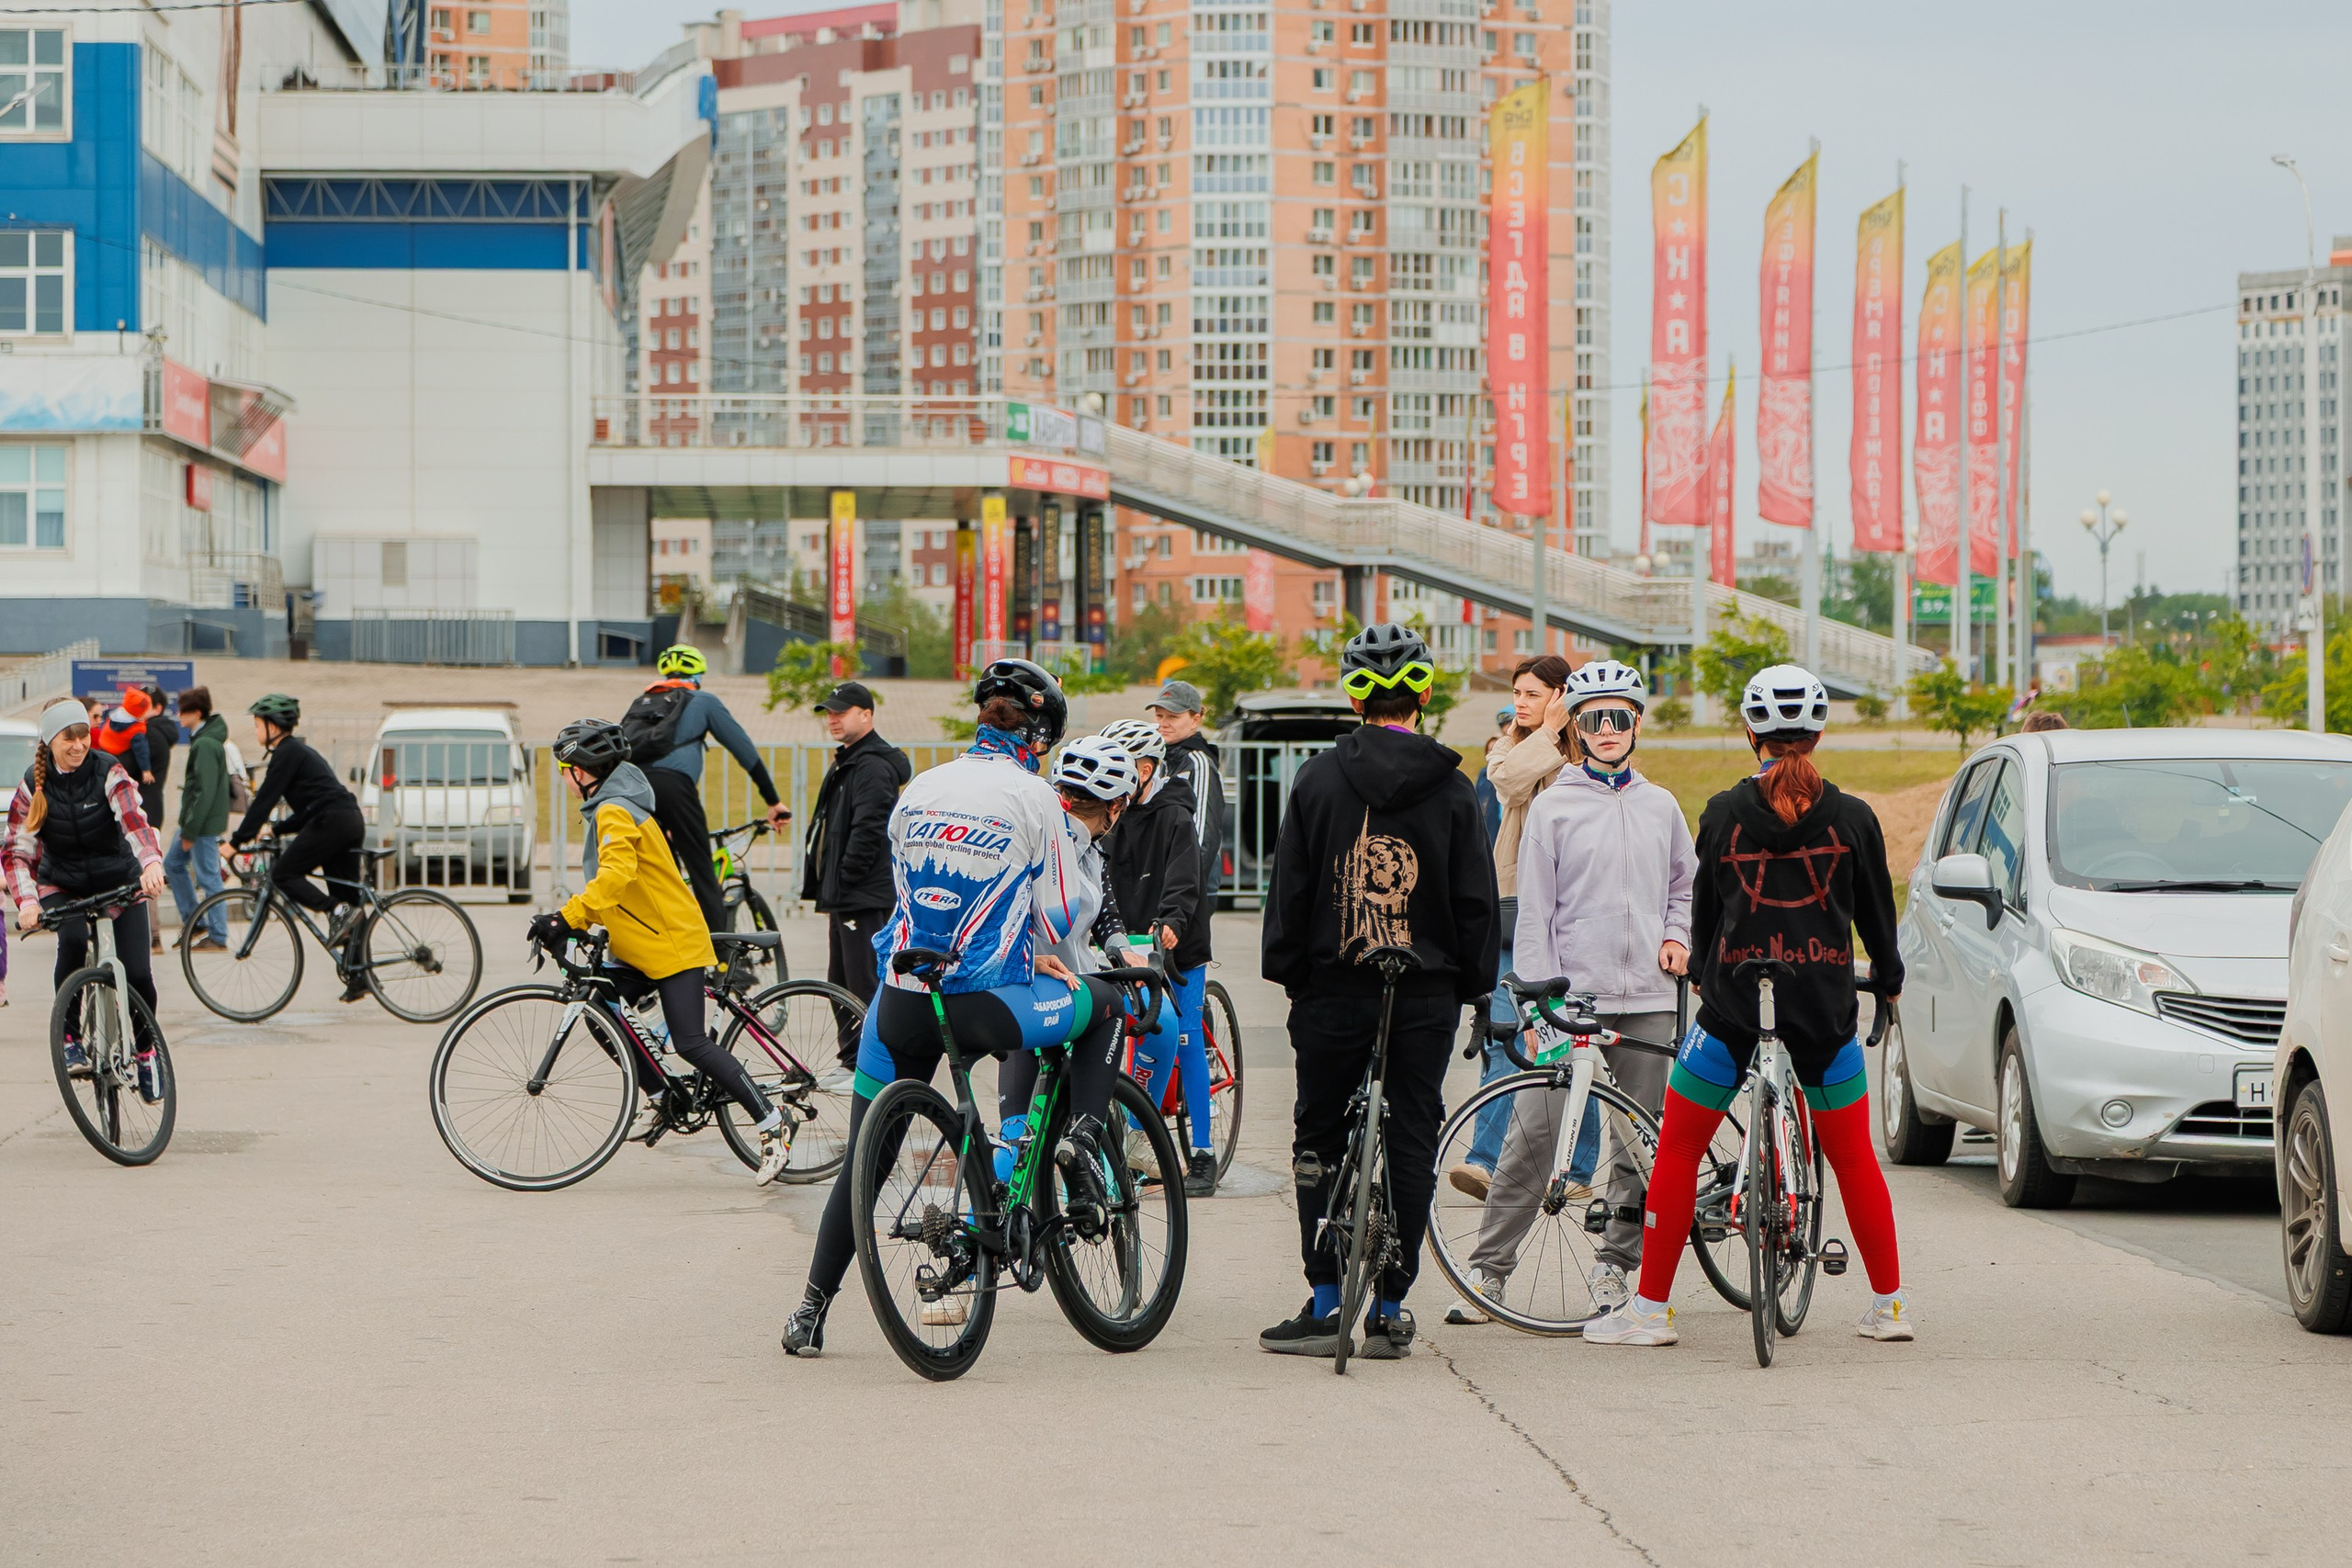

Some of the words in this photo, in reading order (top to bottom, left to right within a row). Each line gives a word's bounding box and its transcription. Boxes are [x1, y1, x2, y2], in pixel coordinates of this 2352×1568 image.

[906, 821, 1012, 853] КАТЮША
[946, 845, 971, 856] cycling
[974, 851, 1000, 861] project
[917, 892, 959, 906] ITERA
[1770, 932, 1806, 964] Not
[1043, 1012, 1059, 1027] КРАЙ
[1105, 1017, 1123, 1065] PINARELLO
[1535, 1022, 1557, 1044] 897
